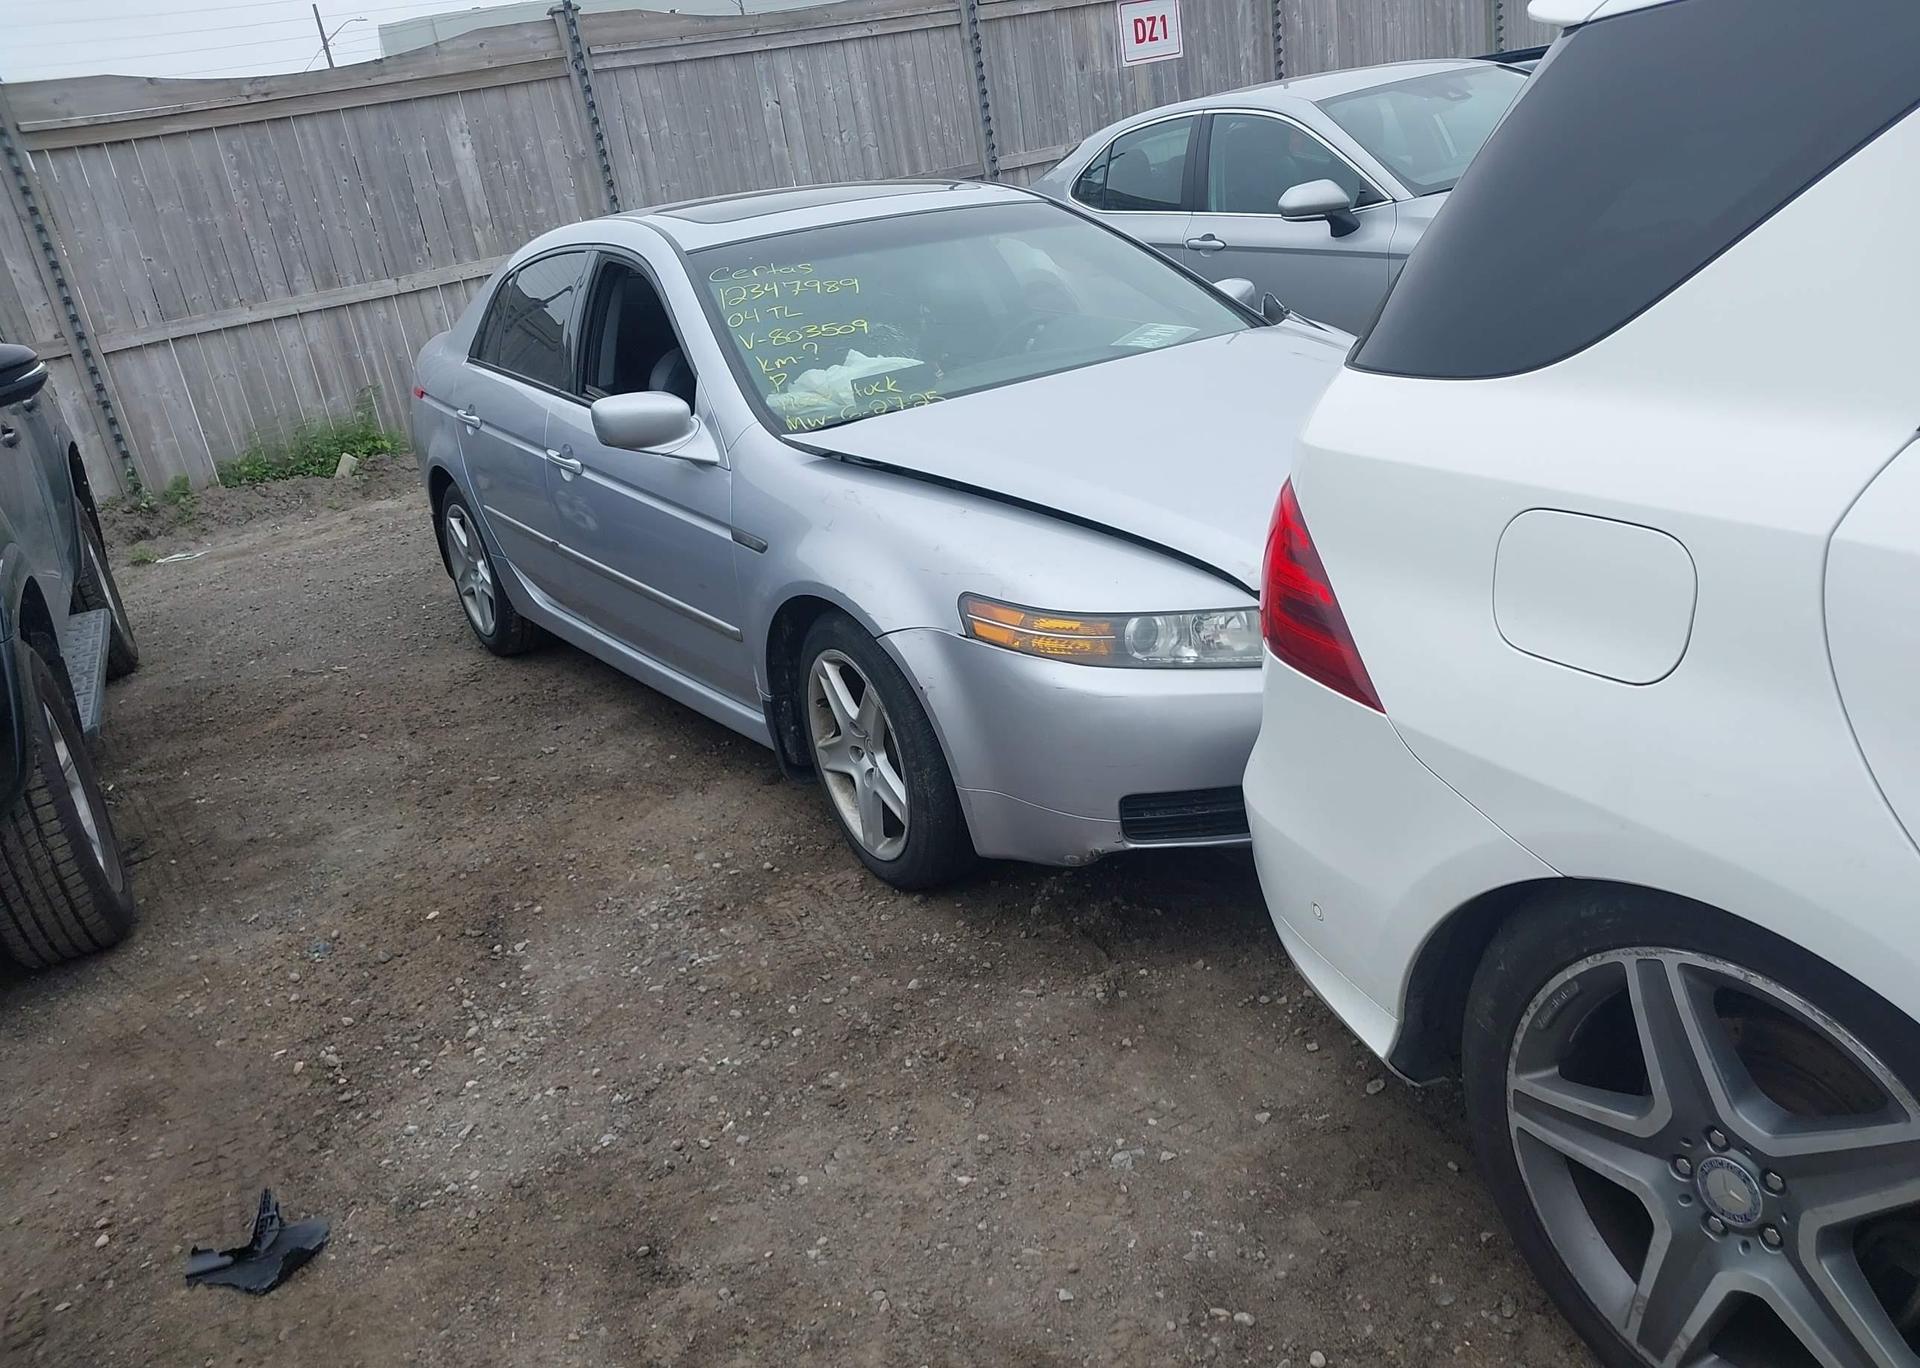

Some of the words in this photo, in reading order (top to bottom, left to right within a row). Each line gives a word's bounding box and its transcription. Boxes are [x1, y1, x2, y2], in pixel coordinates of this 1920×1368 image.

[1133, 14, 1168, 44] DZ1
[719, 278, 860, 310] 12347989
[727, 308, 760, 328] 04
[766, 306, 803, 319] TL
[738, 319, 869, 350] V-803509
